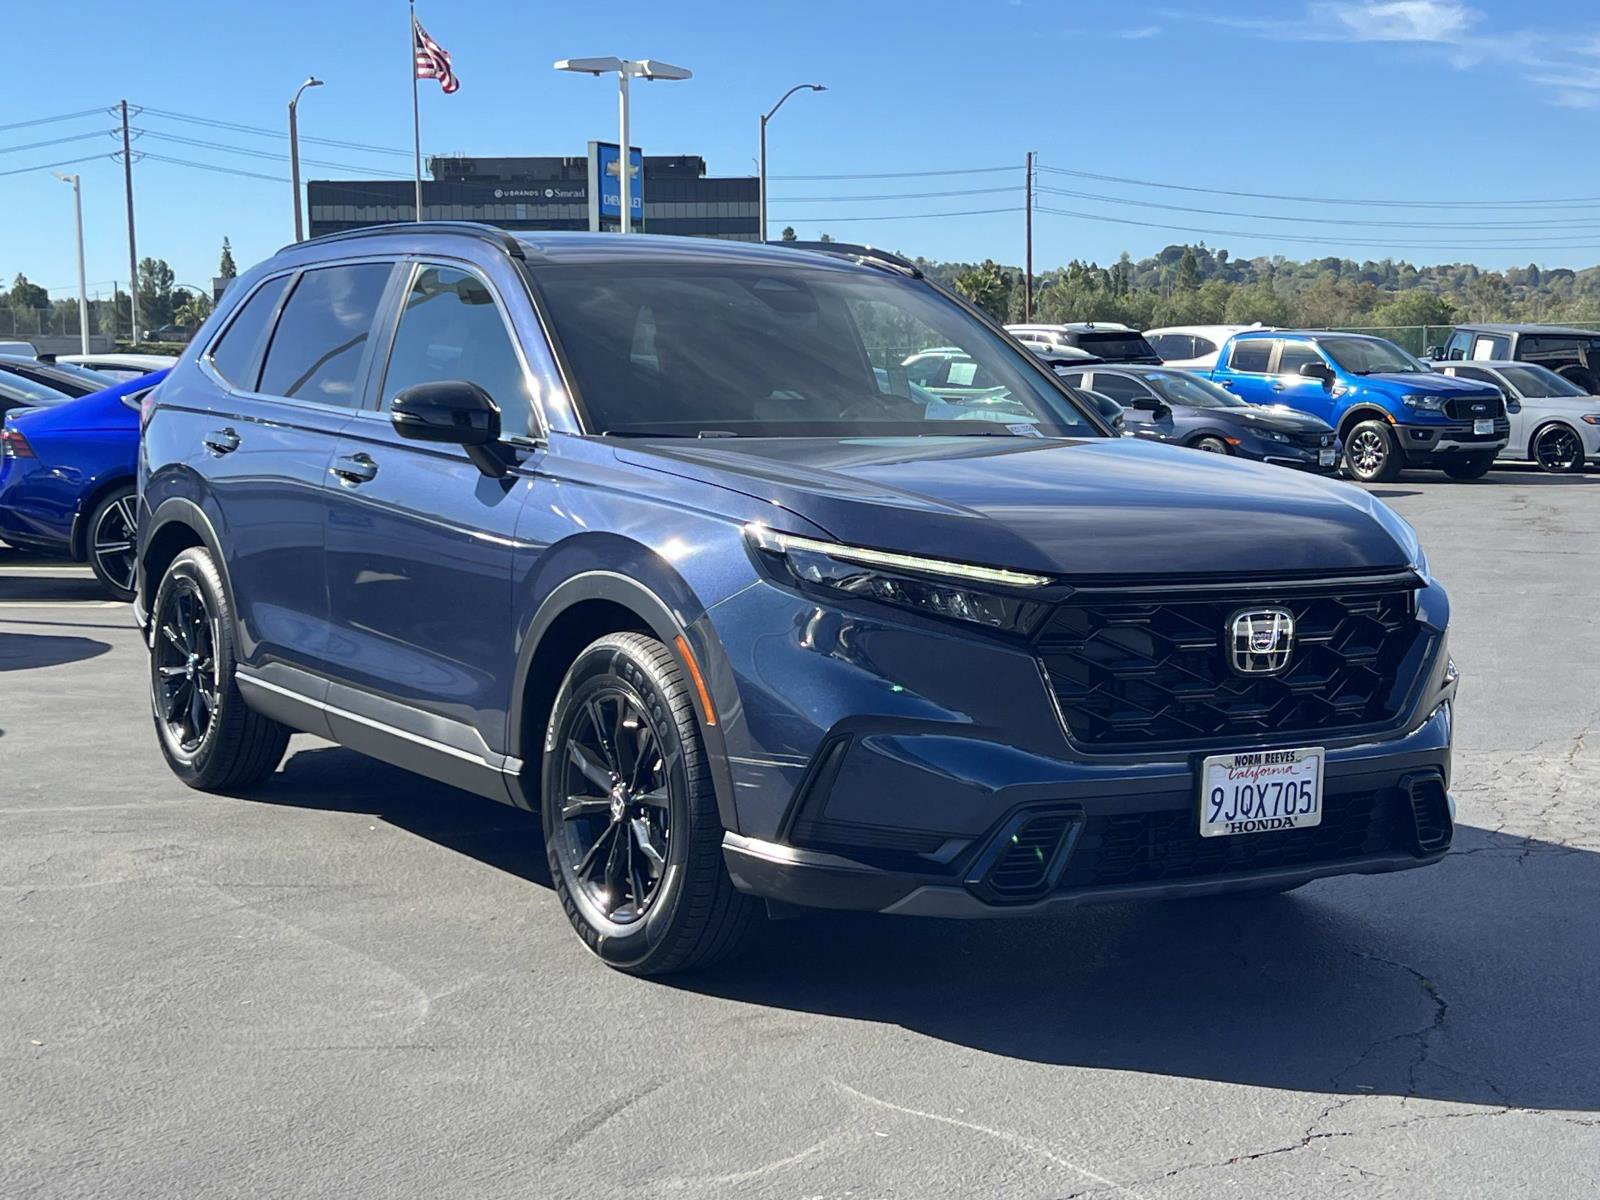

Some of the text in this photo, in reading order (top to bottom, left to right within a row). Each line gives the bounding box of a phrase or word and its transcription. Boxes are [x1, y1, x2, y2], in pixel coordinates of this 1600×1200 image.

[554, 187, 586, 198] Smead
[603, 194, 642, 208] CHEVLET
[1234, 751, 1295, 767] NORM REEVES
[1228, 765, 1300, 783] California
[1208, 780, 1312, 824] 9JQX705
[1229, 817, 1295, 833] HONDA
